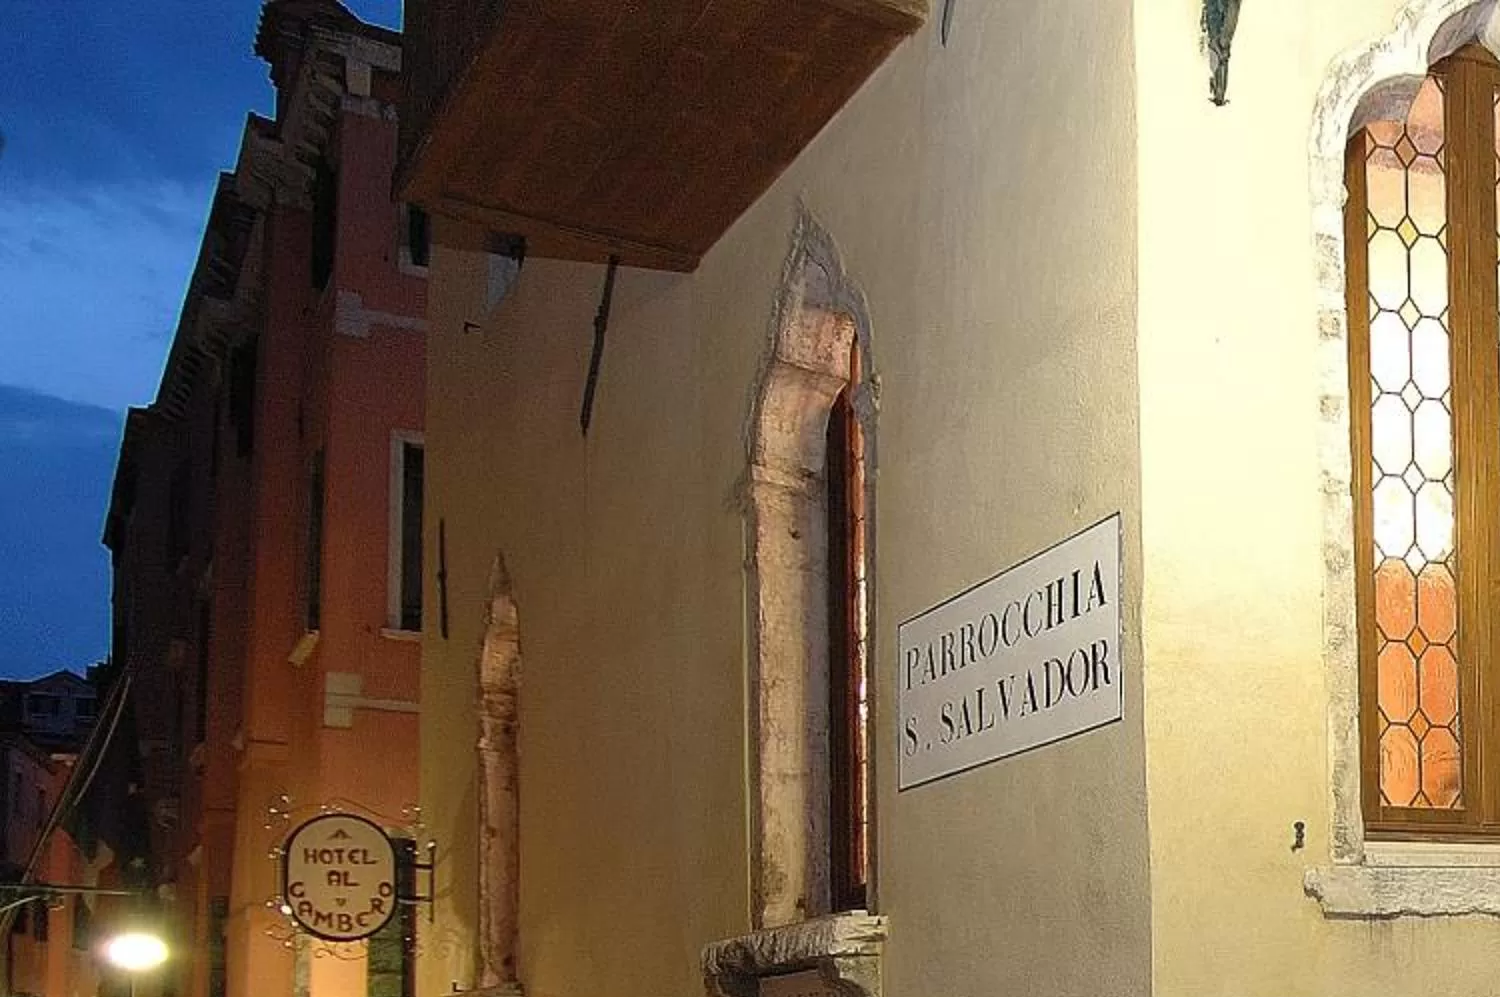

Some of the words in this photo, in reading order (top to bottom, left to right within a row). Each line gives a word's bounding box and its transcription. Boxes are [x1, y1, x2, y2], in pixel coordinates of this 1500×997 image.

[904, 559, 1107, 690] PARROCCHIA
[940, 639, 1111, 744] SALVADOR
[303, 848, 378, 865] HOTEL
[326, 870, 360, 887] AL
